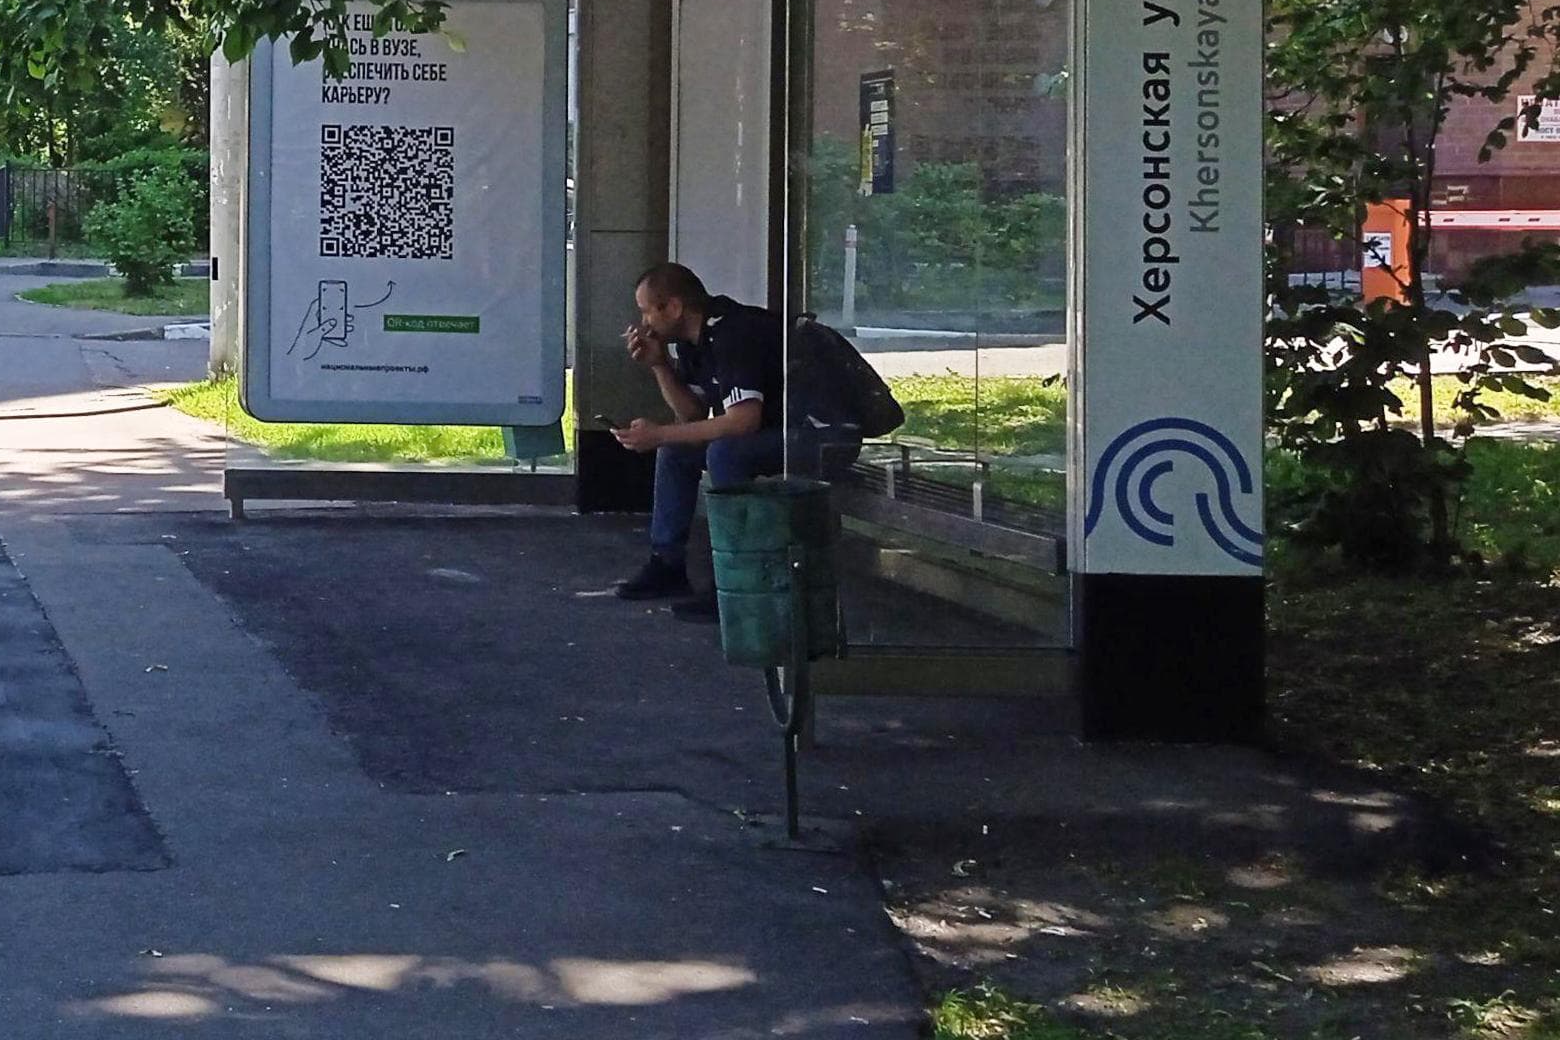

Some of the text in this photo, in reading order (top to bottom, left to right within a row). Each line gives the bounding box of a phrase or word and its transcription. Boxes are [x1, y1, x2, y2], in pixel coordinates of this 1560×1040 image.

[370, 39, 380, 56] В
[383, 39, 422, 58] ВУЗЕ,
[412, 63, 447, 81] СЕБЕ
[321, 86, 391, 105] КАРЬЕРУ?
[1132, 52, 1180, 325] Херсонская
